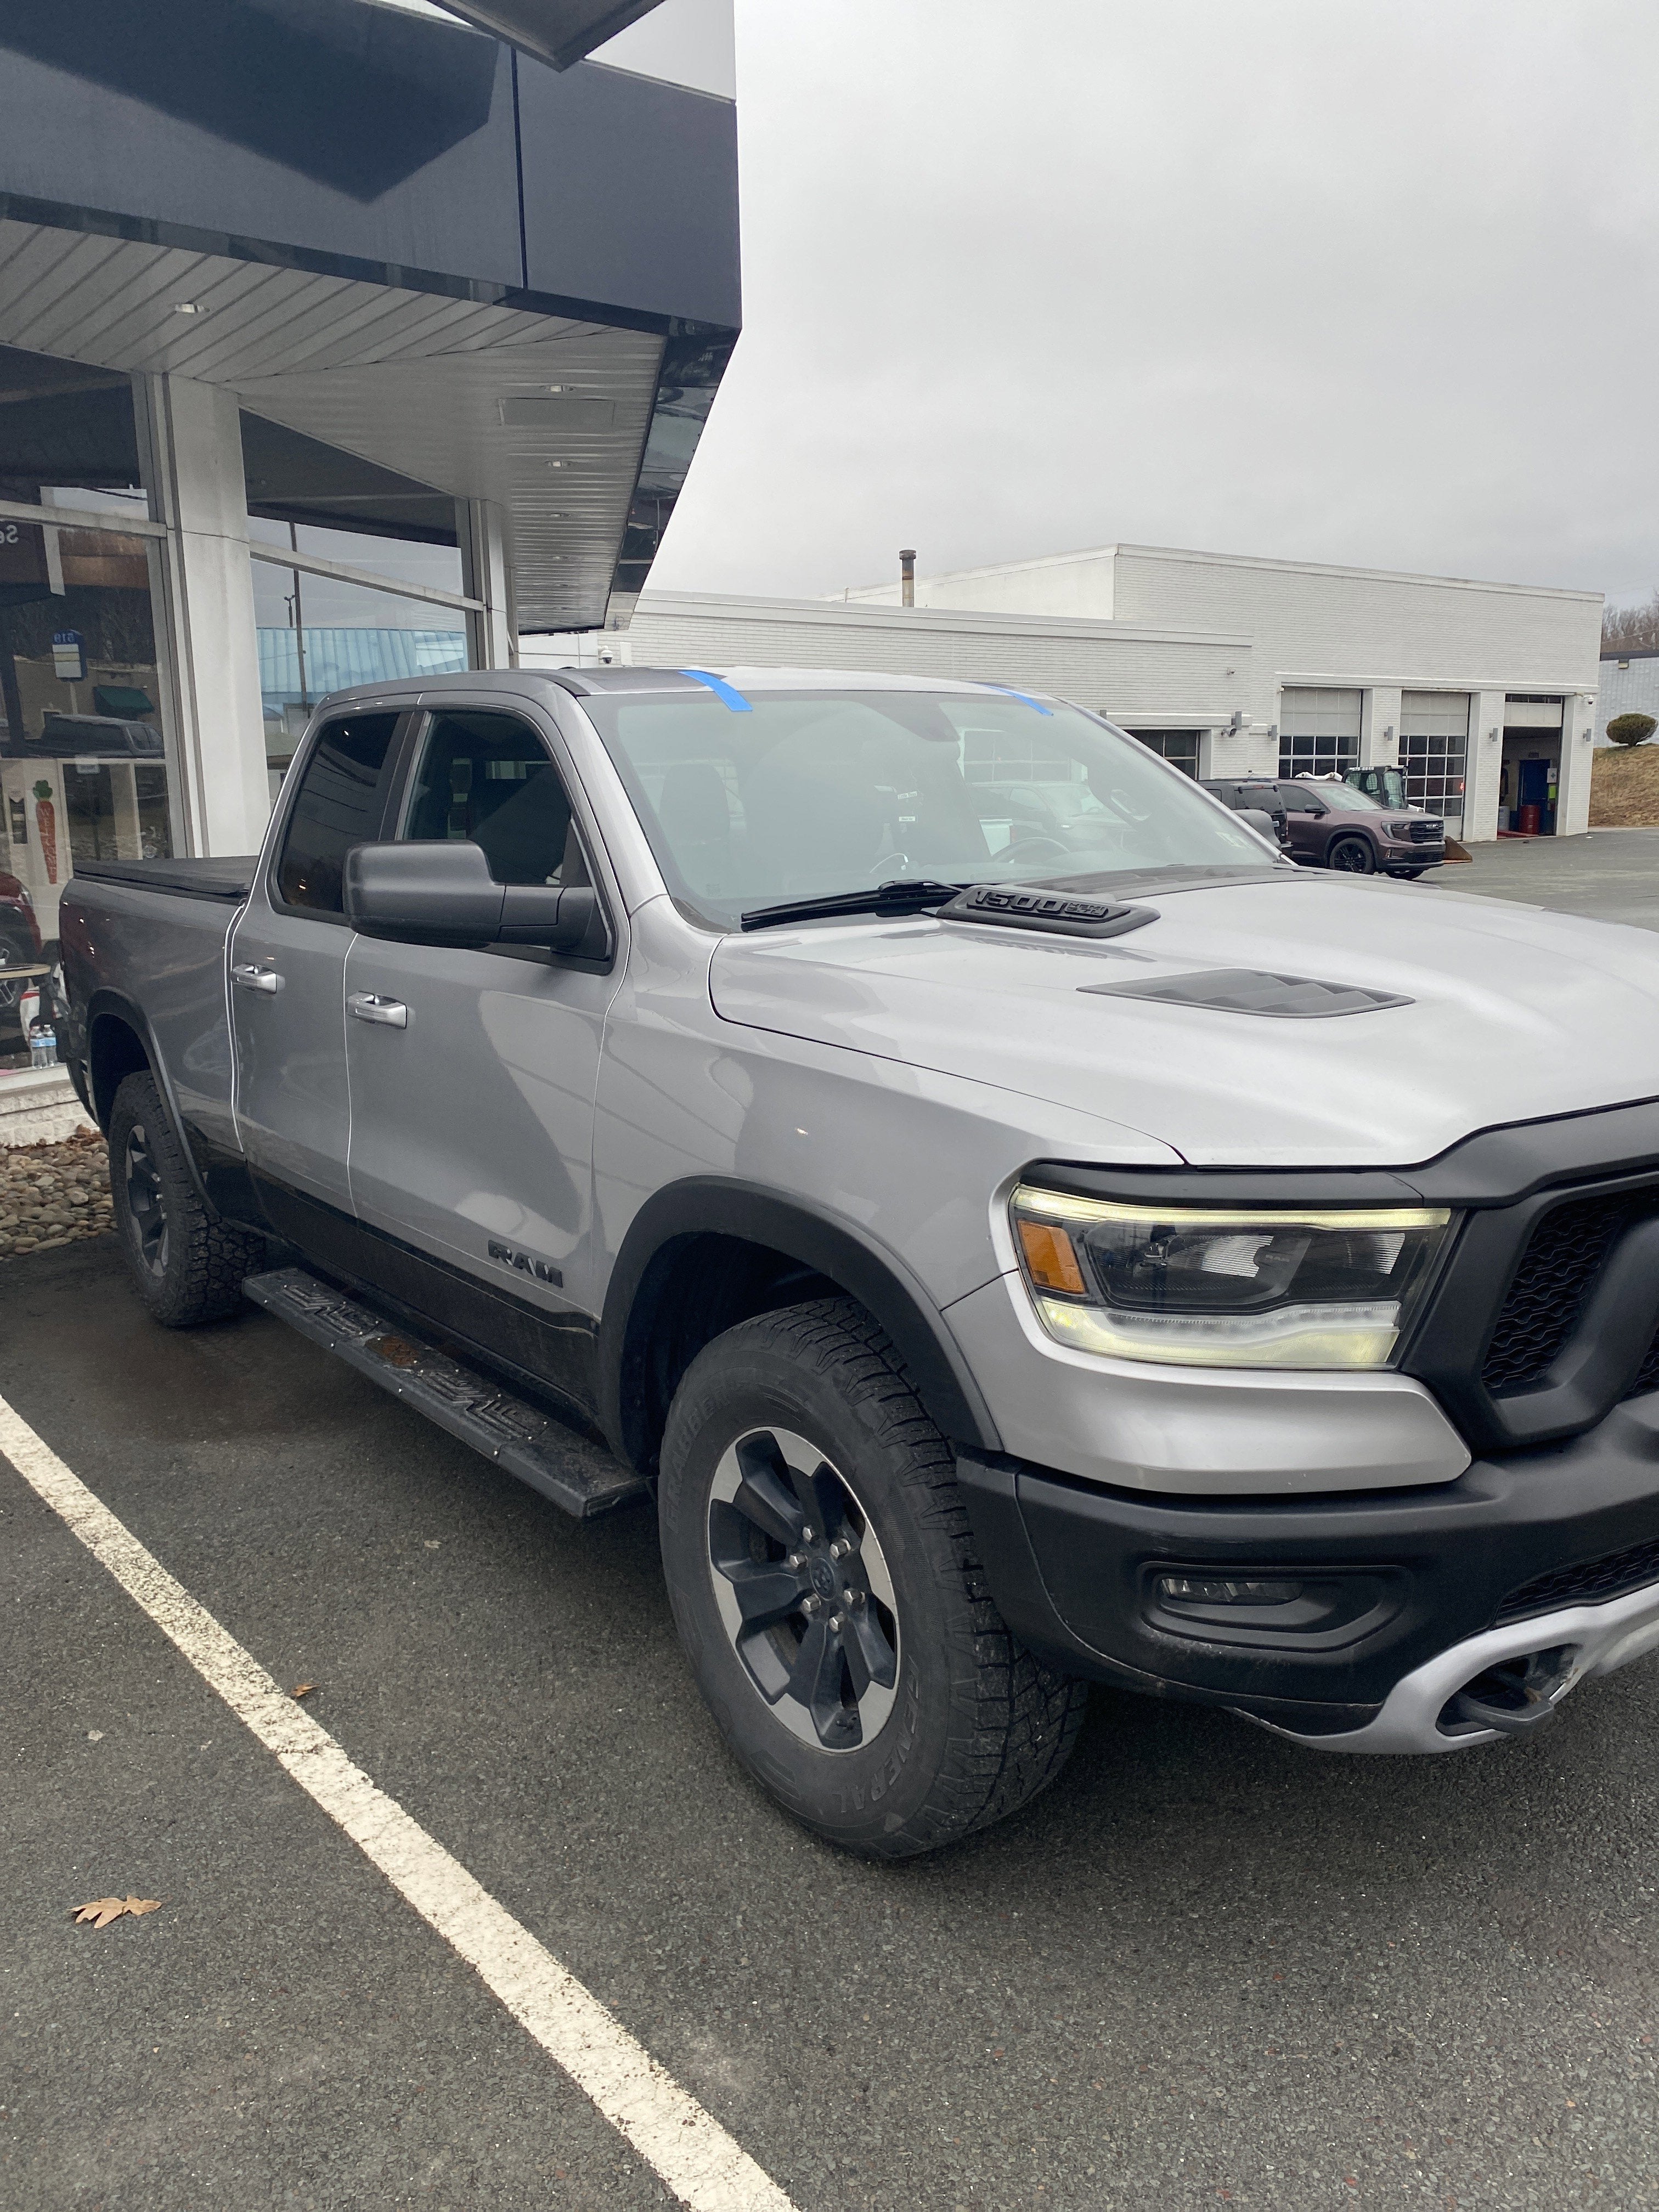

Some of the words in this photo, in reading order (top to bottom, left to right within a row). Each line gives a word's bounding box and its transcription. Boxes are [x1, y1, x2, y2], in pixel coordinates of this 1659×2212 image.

[975, 890, 1067, 914] 1500
[488, 1239, 563, 1288] RAM
[830, 1653, 920, 1813] GENERAL
